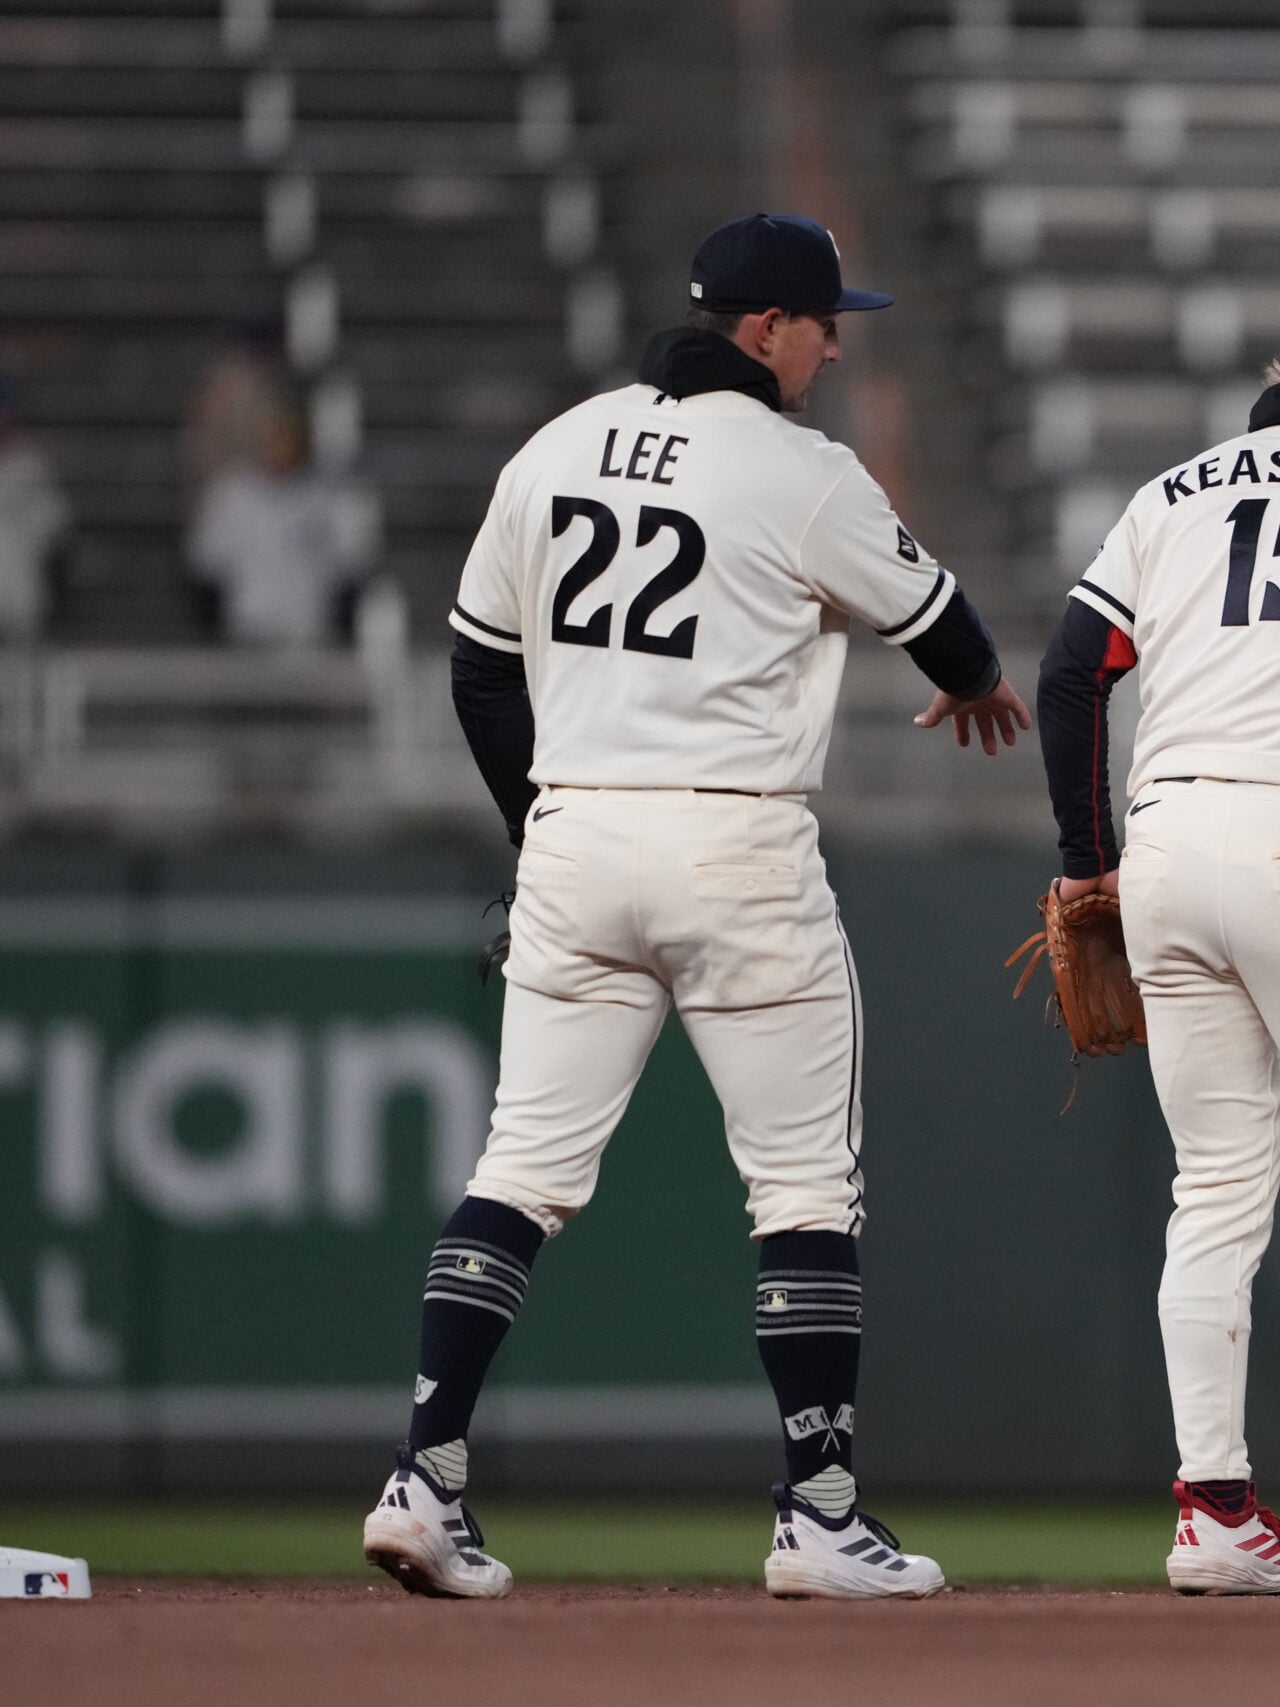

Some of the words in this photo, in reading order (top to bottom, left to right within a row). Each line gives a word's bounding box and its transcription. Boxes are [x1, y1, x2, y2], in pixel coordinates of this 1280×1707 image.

[599, 428, 690, 486] LEE
[551, 495, 707, 660] 22
[0, 1017, 498, 1224] ian
[793, 1413, 817, 1433] M
